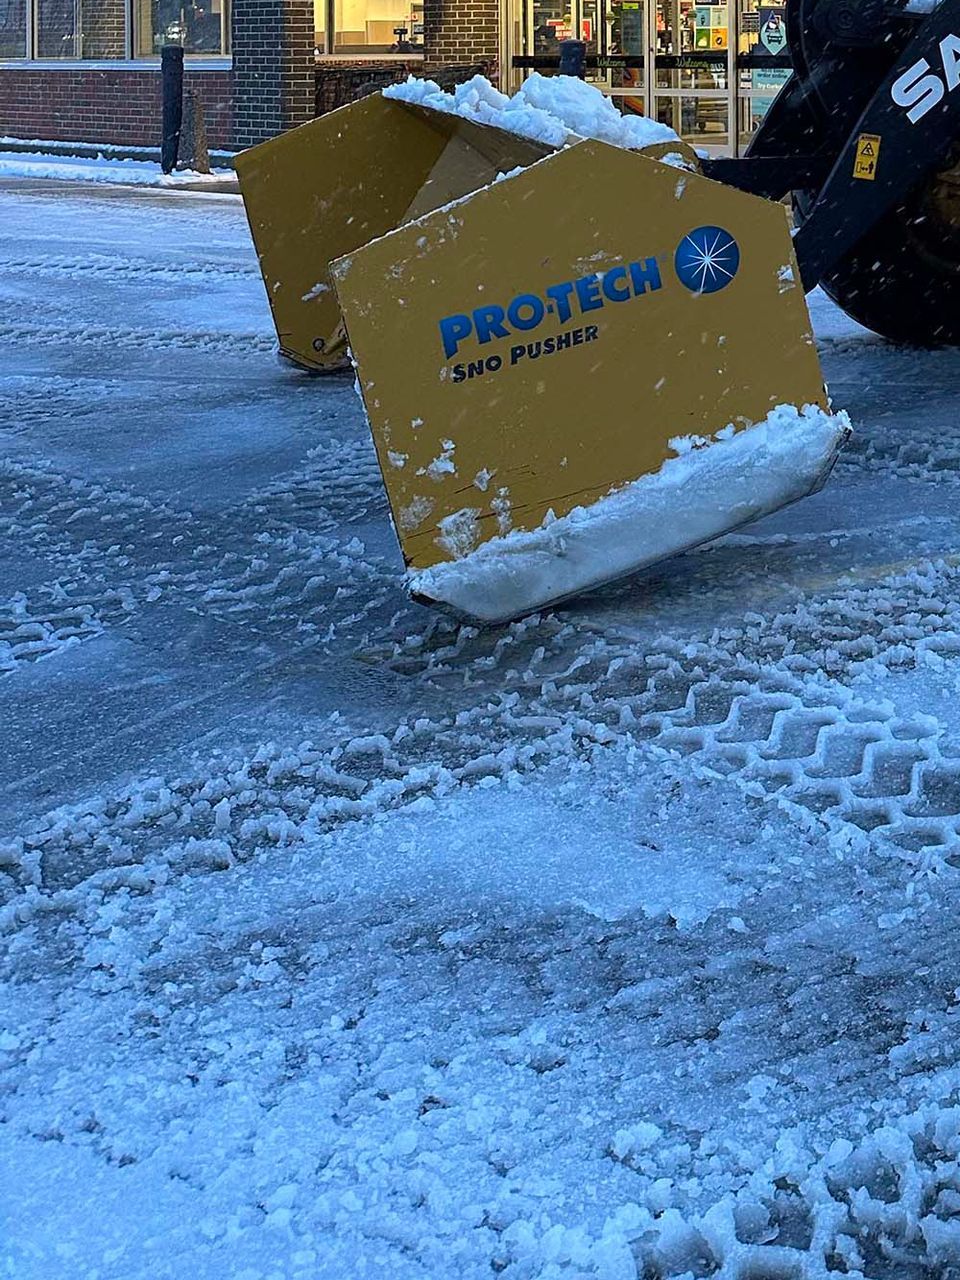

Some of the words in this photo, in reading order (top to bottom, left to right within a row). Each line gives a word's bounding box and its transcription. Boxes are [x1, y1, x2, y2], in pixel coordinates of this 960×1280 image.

[596, 56, 627, 67] Welcome
[452, 354, 502, 384] SNO
[510, 325, 599, 365] PUSHER
